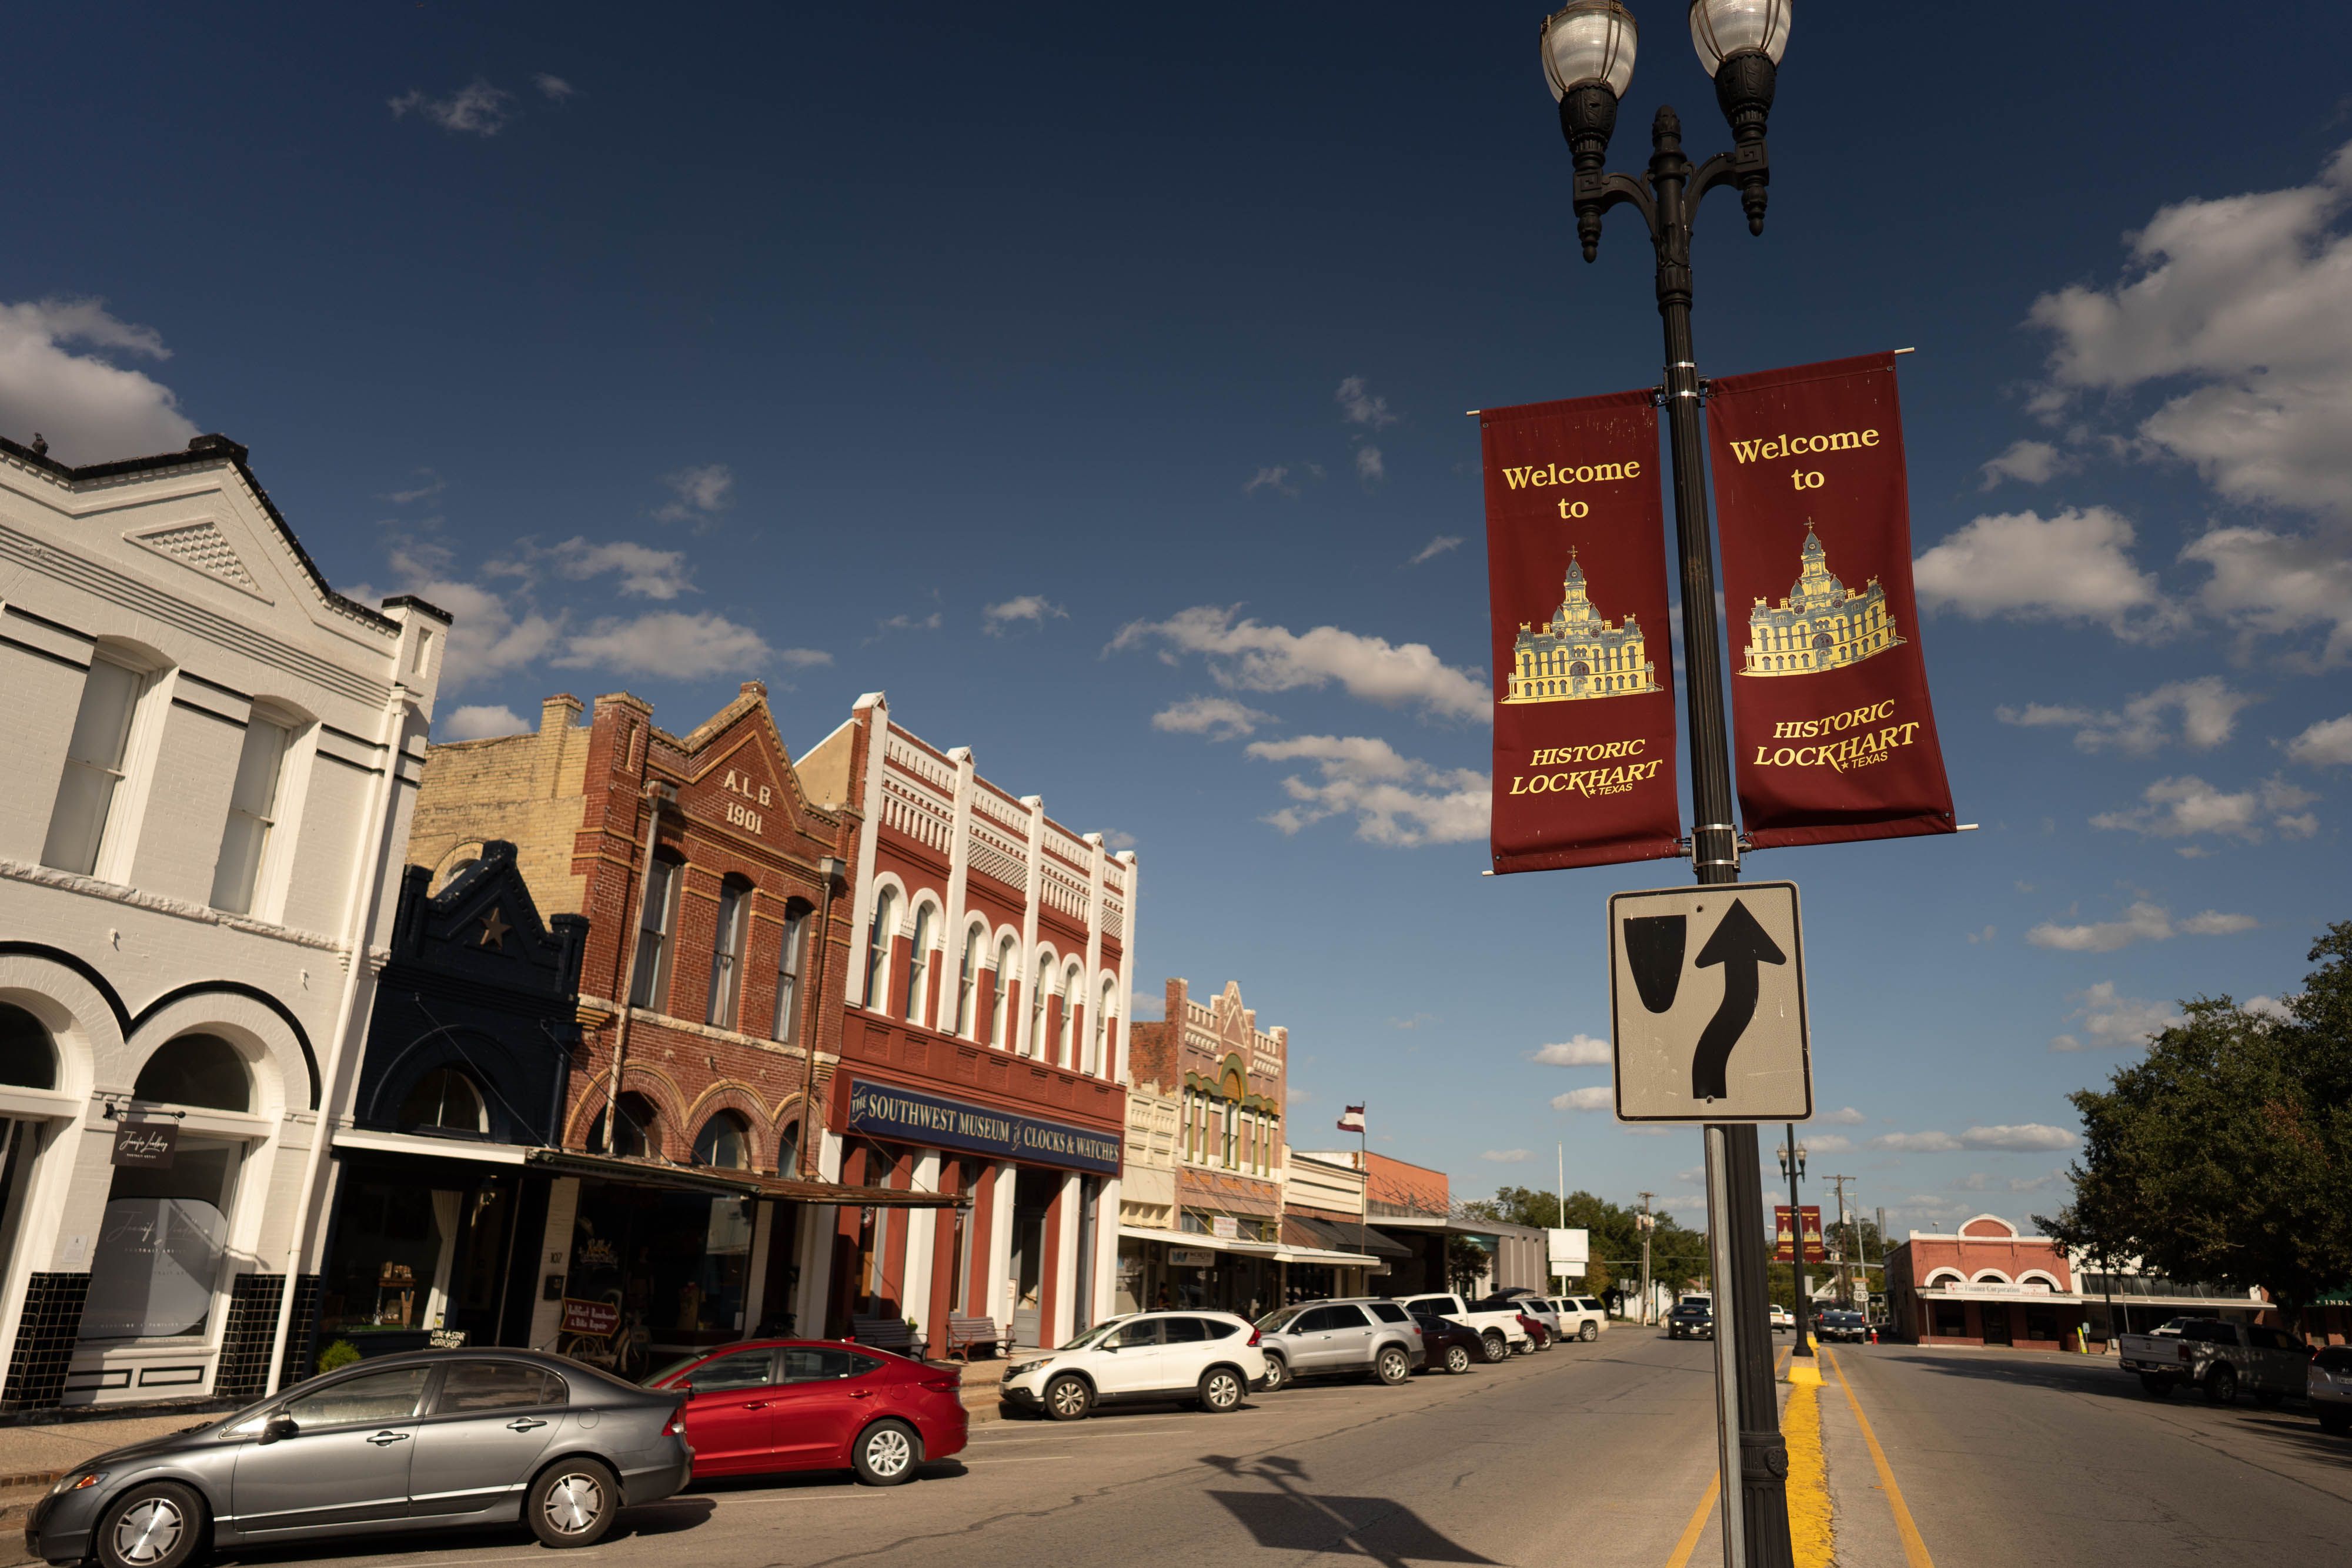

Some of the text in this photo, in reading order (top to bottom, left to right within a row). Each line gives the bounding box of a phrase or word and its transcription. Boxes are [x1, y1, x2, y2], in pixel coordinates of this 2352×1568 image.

[1729, 429, 1880, 464] Welcome
[1502, 460, 1641, 490] Welcome
[1791, 469, 1825, 491] to
[1558, 497, 1589, 519] to
[1773, 698, 1895, 738] HISTORIC
[1529, 738, 1645, 766] HISTORIC
[1753, 721, 1919, 774] LOCKHART
[1852, 751, 1888, 769] TEXAS
[1509, 758, 1663, 798] LOCKHART
[1599, 783, 1633, 795] TEXAS
[726, 801, 762, 835] 1901
[851, 1095, 867, 1114] THE
[868, 1094, 957, 1132] SOUTHWEST
[958, 1112, 1010, 1142] MUSEUM
[1024, 1126, 1065, 1153] CLOCKS
[1067, 1135, 1075, 1155] &
[1076, 1136, 1120, 1163] WATCHES
[1986, 1285, 2020, 1294] Corporation
